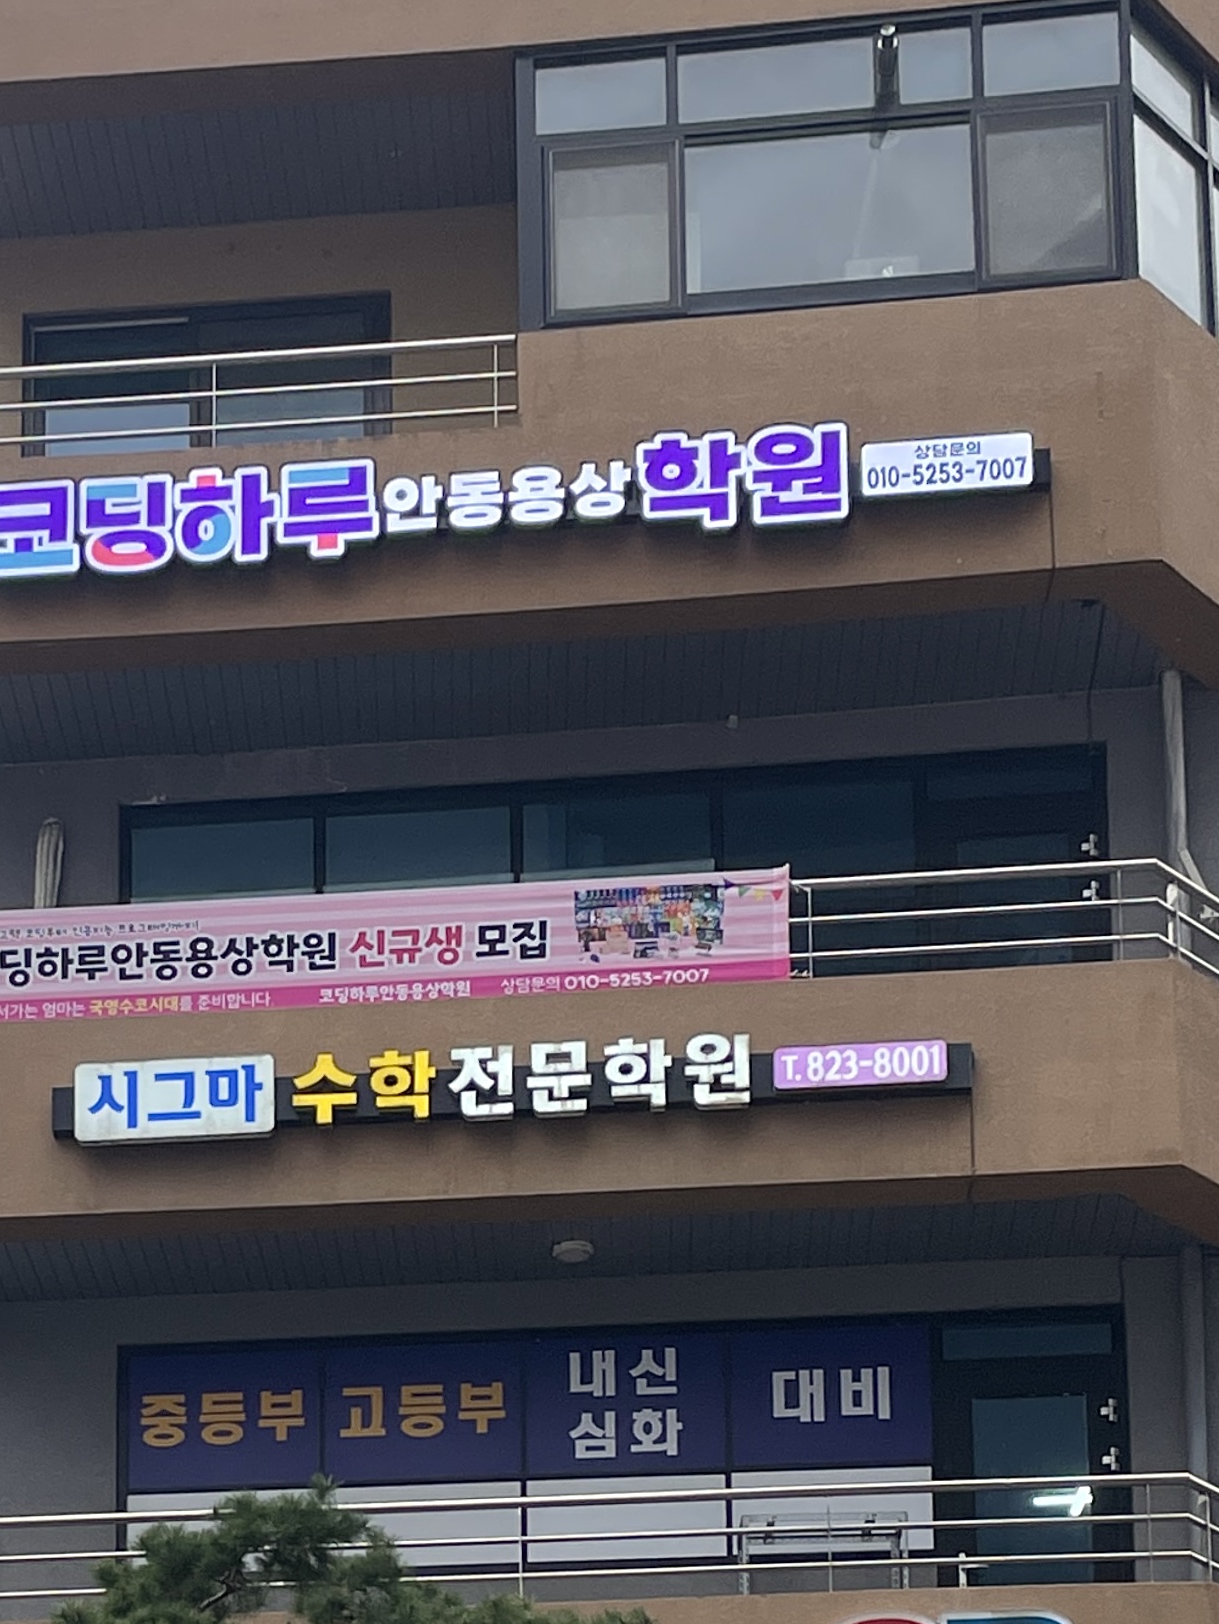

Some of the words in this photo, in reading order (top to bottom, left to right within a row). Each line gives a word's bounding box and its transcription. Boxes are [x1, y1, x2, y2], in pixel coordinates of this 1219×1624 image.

[867, 456, 1028, 489] 010-5253-7007
[914, 441, 981, 460] 상담문의
[383, 459, 632, 533] 안동용상
[636, 421, 849, 531] 학원
[349, 924, 463, 968] 신규생
[475, 919, 548, 960] 모집
[319, 980, 471, 1003] 코딩하루안동용상학원
[501, 975, 561, 995] 상담문의
[564, 968, 710, 990] 010-5253-7007
[42, 1001, 86, 1018] 엄마는
[88, 1064, 263, 1128] 시그마
[292, 1049, 437, 1125] 수학
[448, 1032, 751, 1120] 전문학원
[568, 1346, 679, 1397] 내신
[771, 1365, 892, 1423] 대비
[139, 1389, 306, 1448] 중등부
[339, 1381, 507, 1438] 고등부
[568, 1407, 683, 1460] 심화
